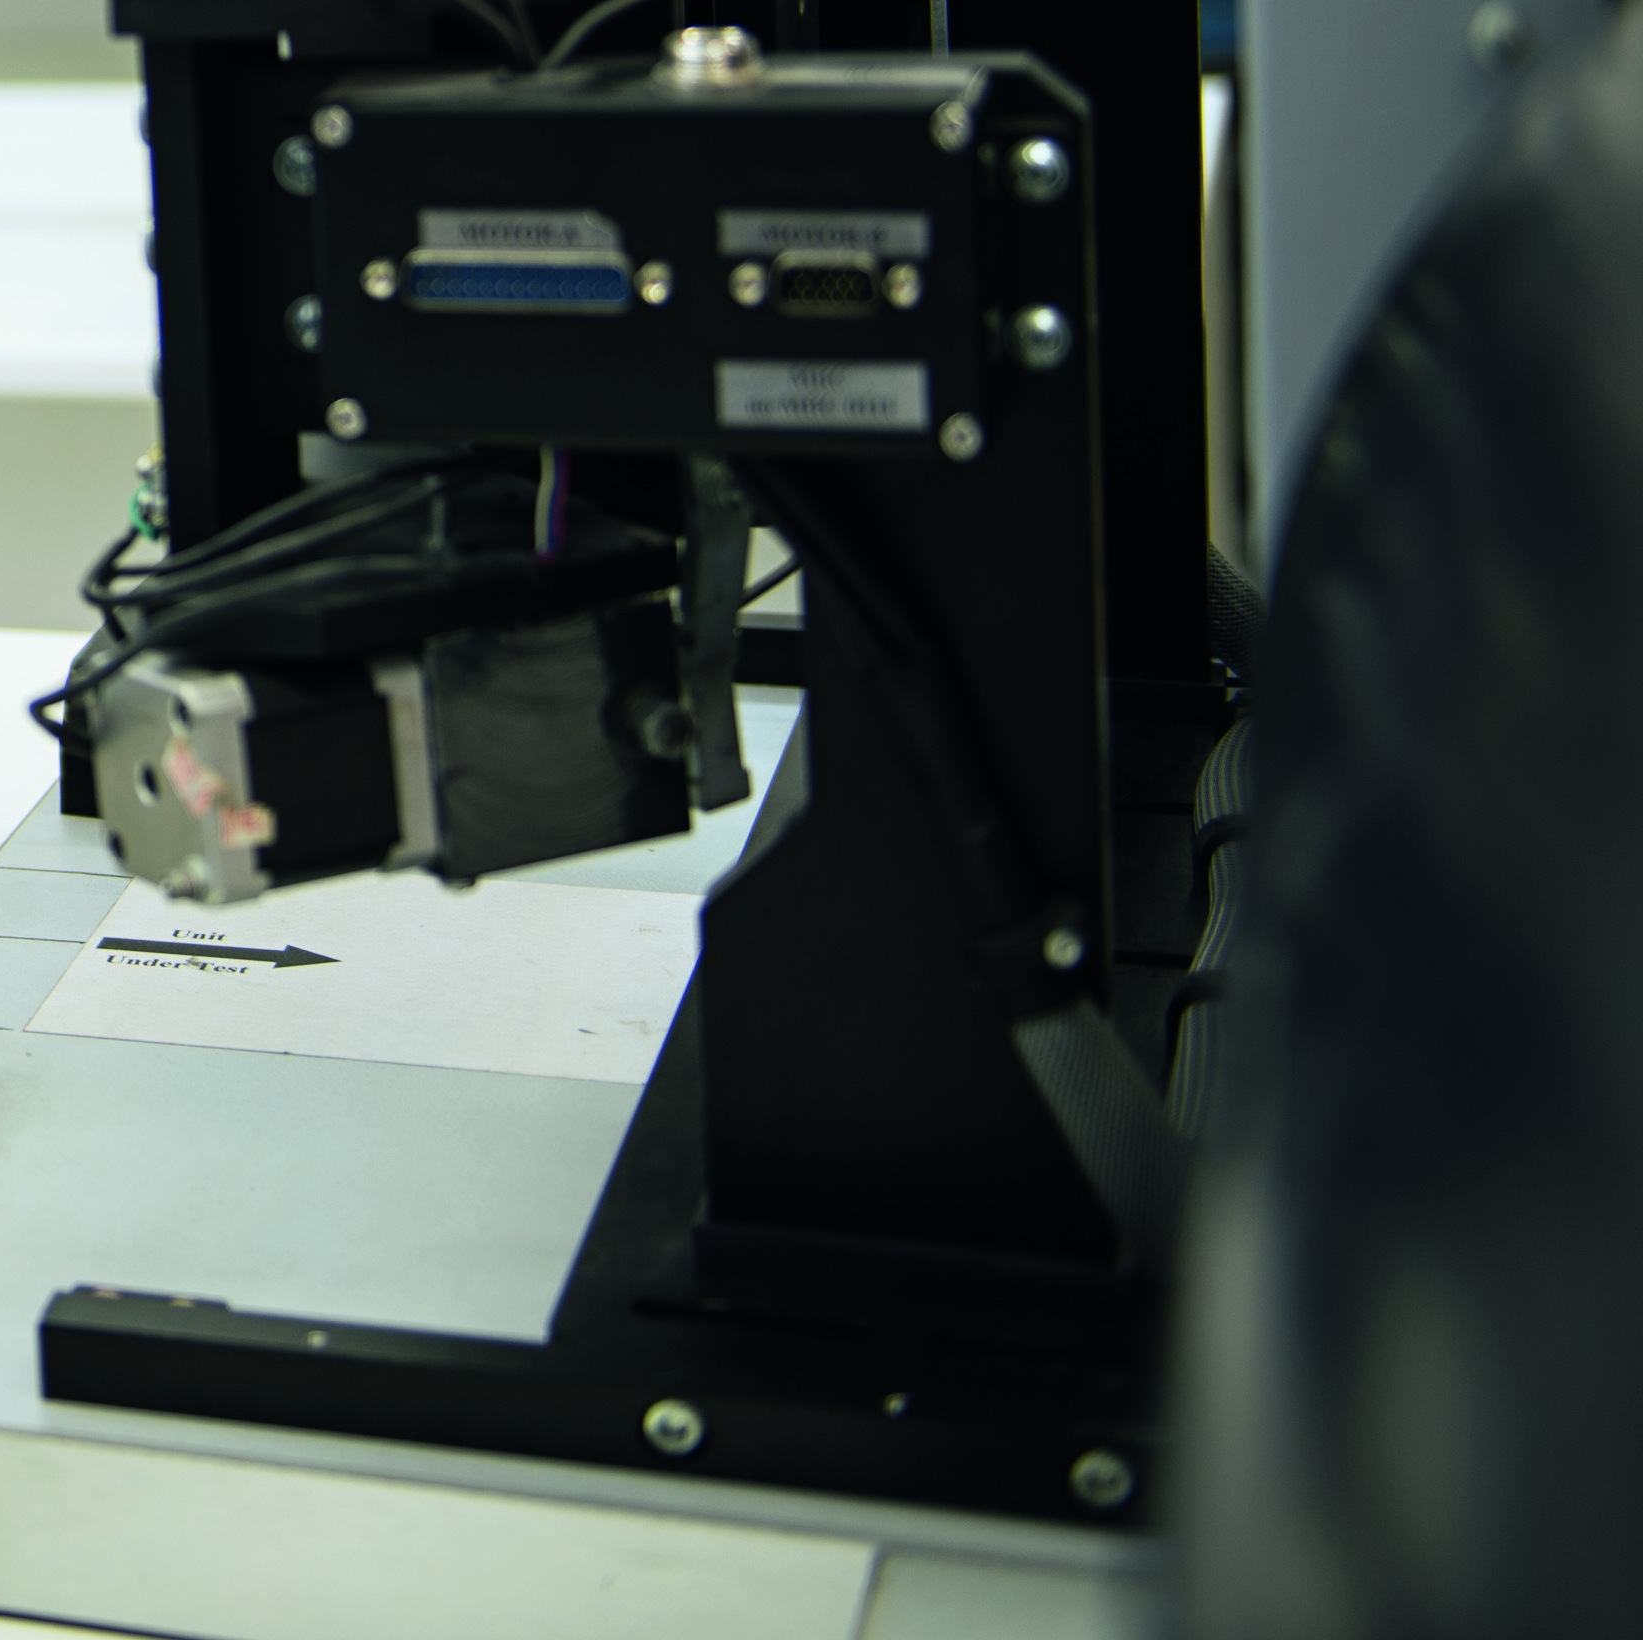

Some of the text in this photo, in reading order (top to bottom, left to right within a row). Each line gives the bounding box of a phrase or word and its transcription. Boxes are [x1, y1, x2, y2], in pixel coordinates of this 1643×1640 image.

[172, 929, 226, 941] Unit
[106, 955, 249, 974] Under Test
